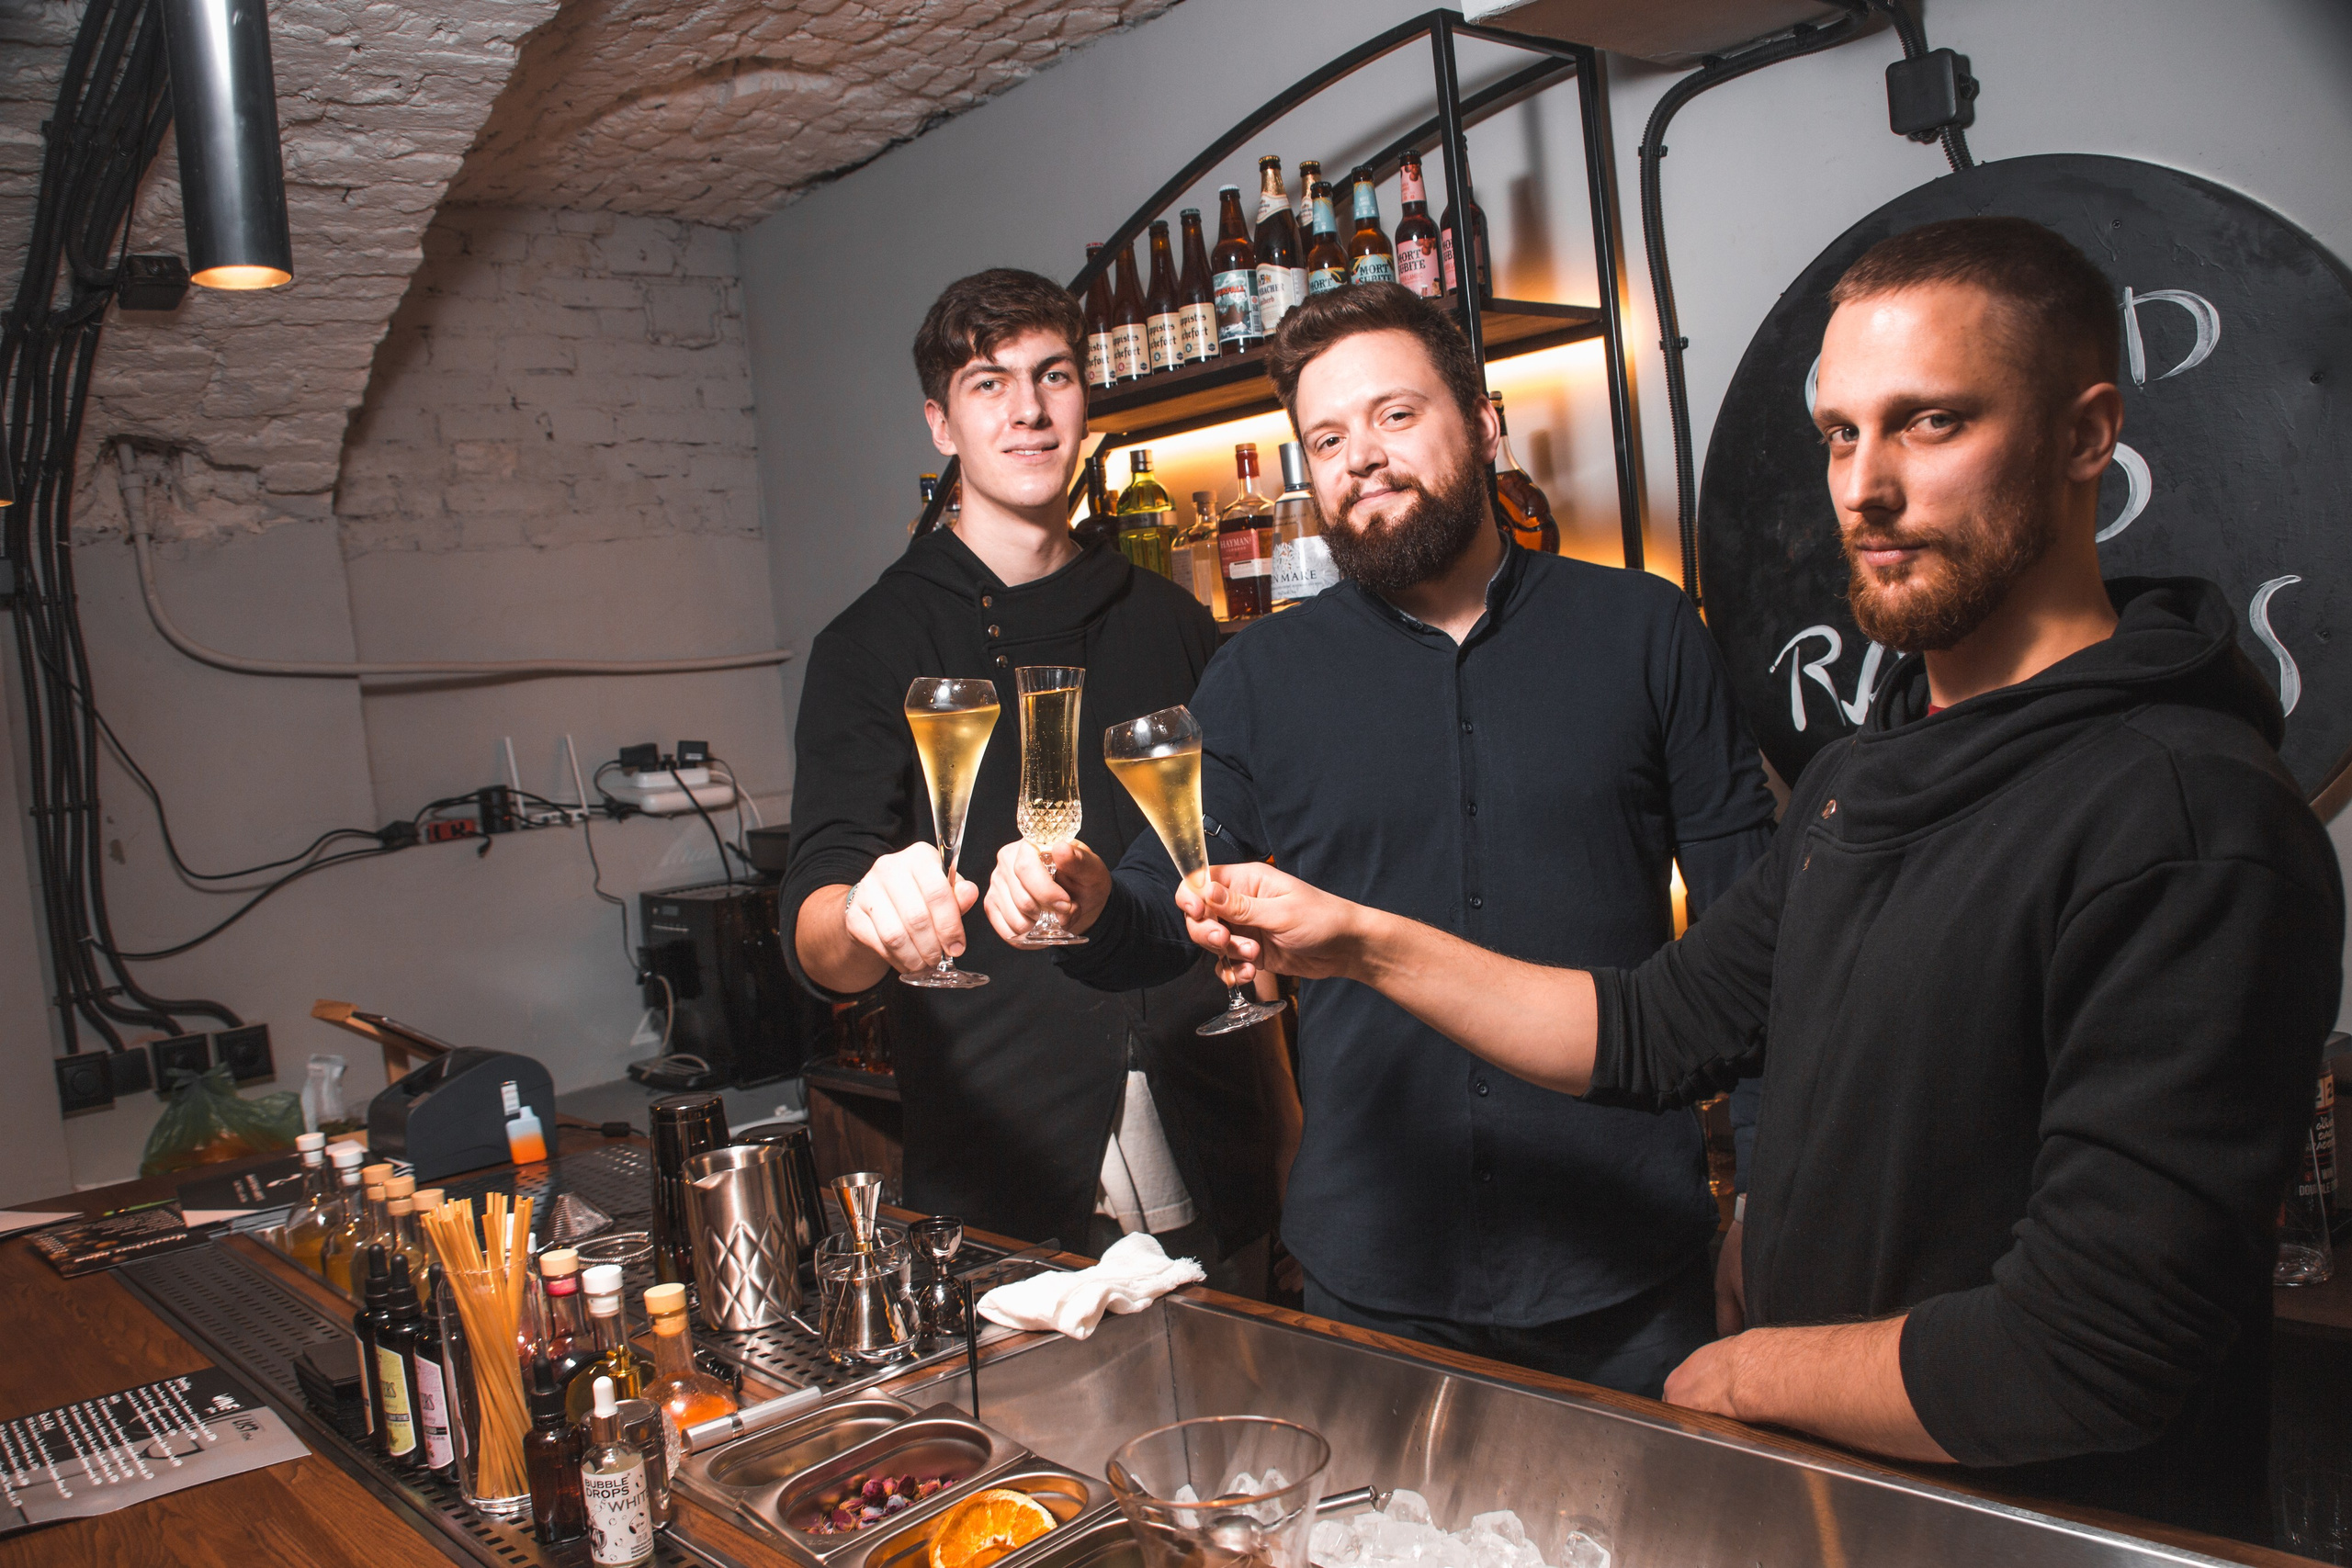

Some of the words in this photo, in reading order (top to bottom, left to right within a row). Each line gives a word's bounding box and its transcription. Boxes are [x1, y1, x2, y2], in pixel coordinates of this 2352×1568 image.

[1360, 264, 1389, 276] MORT
[585, 1477, 628, 1489] BUBBLE
[586, 1486, 629, 1499] DROPS
